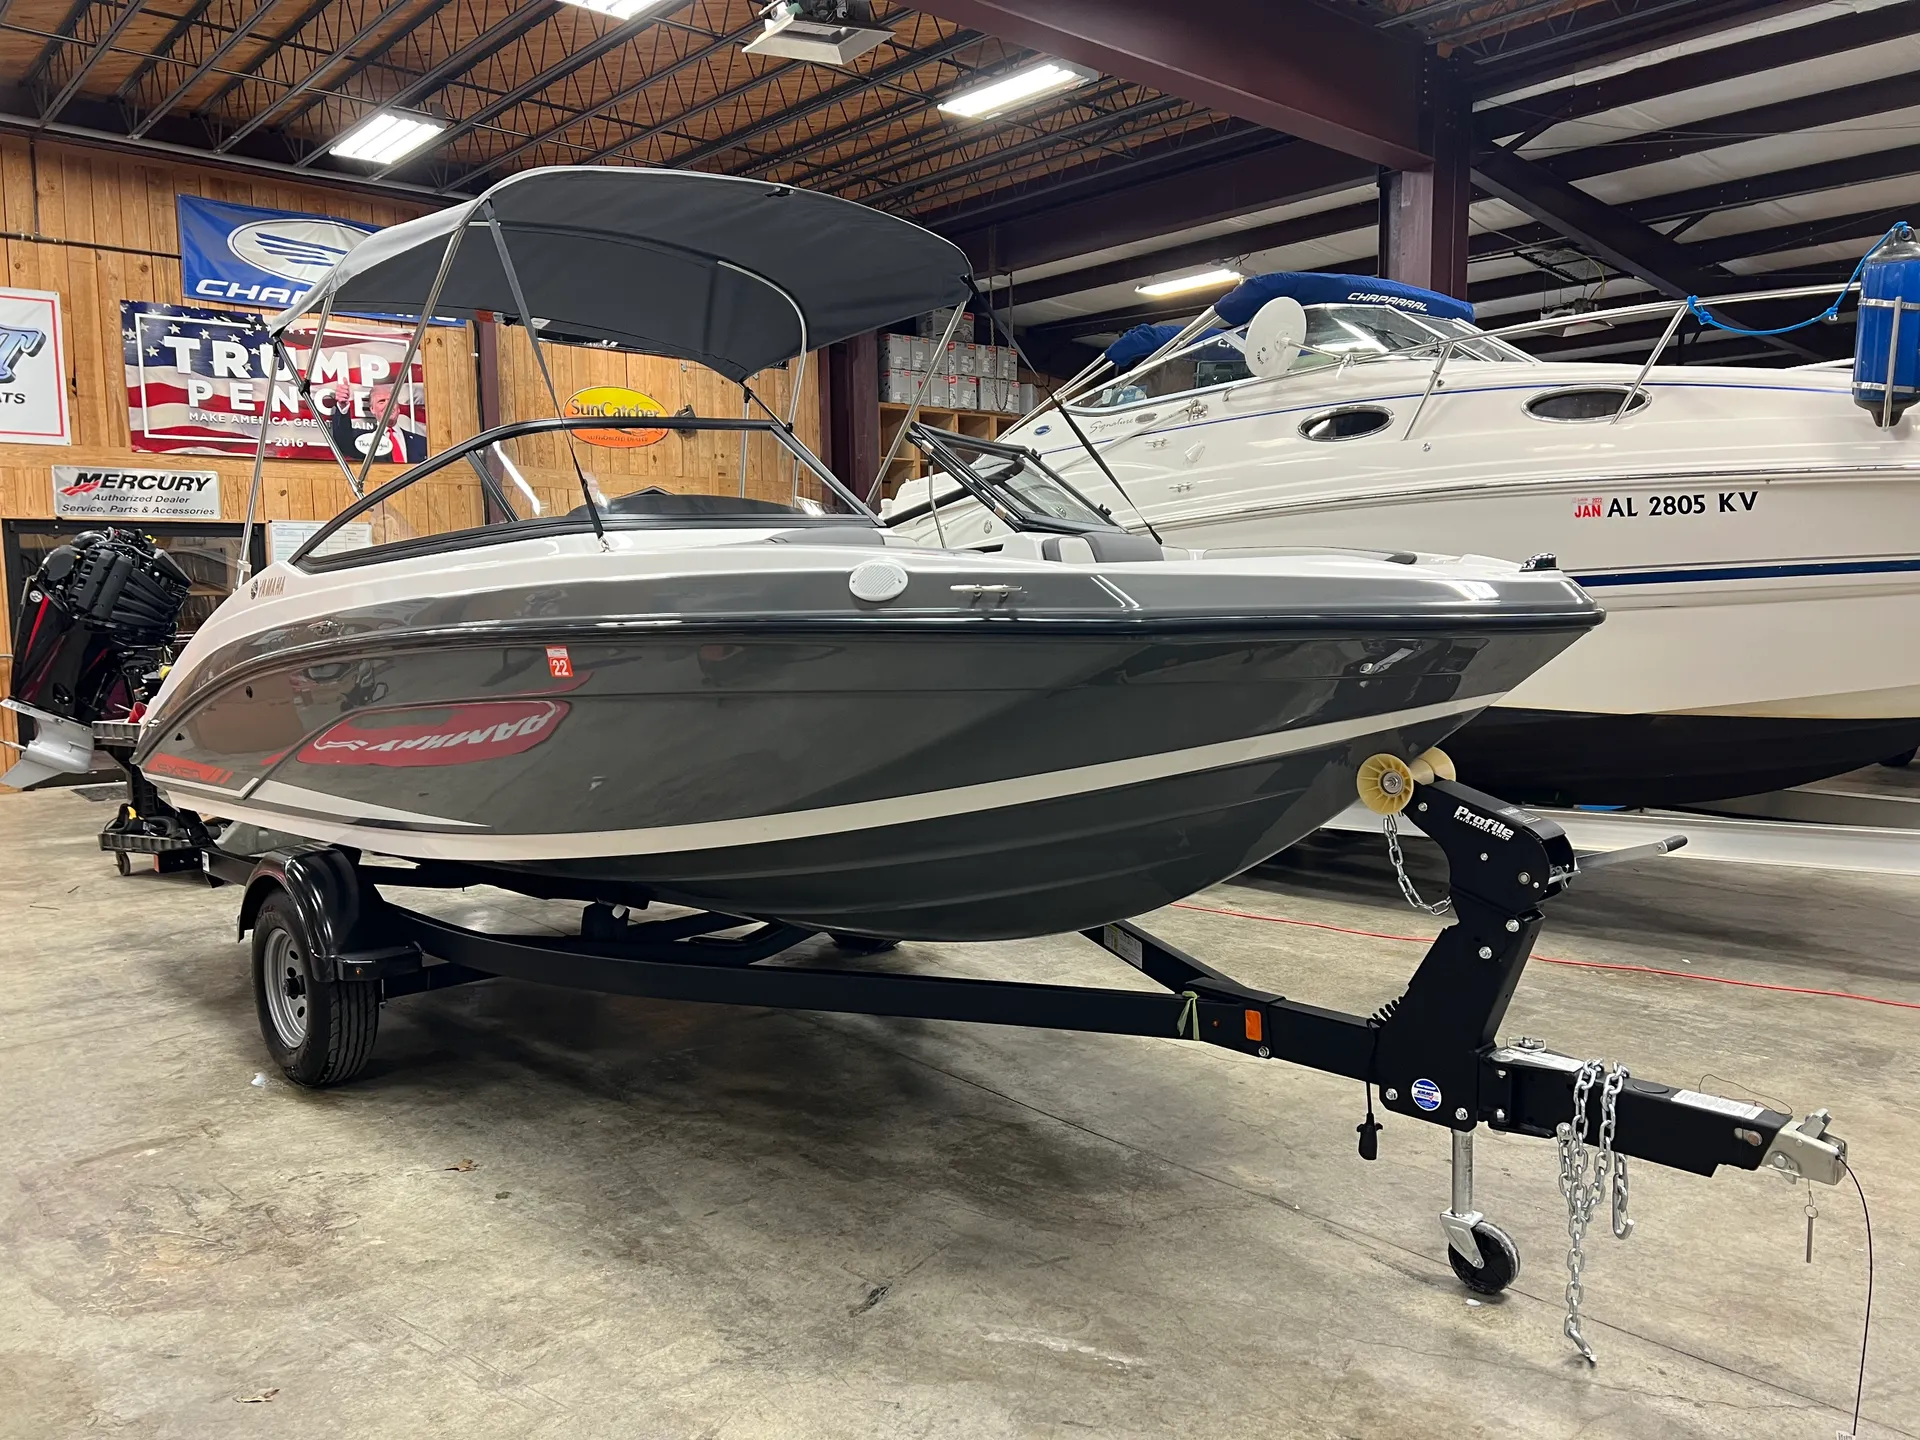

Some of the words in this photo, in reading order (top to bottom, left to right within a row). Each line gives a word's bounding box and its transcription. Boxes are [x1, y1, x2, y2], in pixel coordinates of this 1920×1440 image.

[1347, 292, 1428, 312] CHAPARRAL
[163, 335, 391, 388] TRUMP
[0, 392, 26, 404] TS
[187, 379, 377, 419] PENCE
[571, 398, 660, 419] SunCatcher
[189, 412, 226, 423] MAKE
[294, 418, 333, 429] GRET
[274, 437, 304, 448] 2016
[586, 435, 626, 443] AUTHORIZED
[73, 472, 212, 492] MERCURY
[92, 493, 151, 503] Authorized
[155, 495, 190, 504] Dealer
[1574, 505, 1602, 518] JAN
[1607, 497, 1638, 518] AL
[1648, 494, 1706, 517] 2805
[1718, 491, 1759, 513] KV
[62, 503, 105, 514] Service,
[109, 505, 138, 514] Parts
[141, 506, 149, 514] &
[151, 506, 215, 516] Accessories
[552, 659, 570, 676] 22
[1455, 805, 1515, 839] Profile
